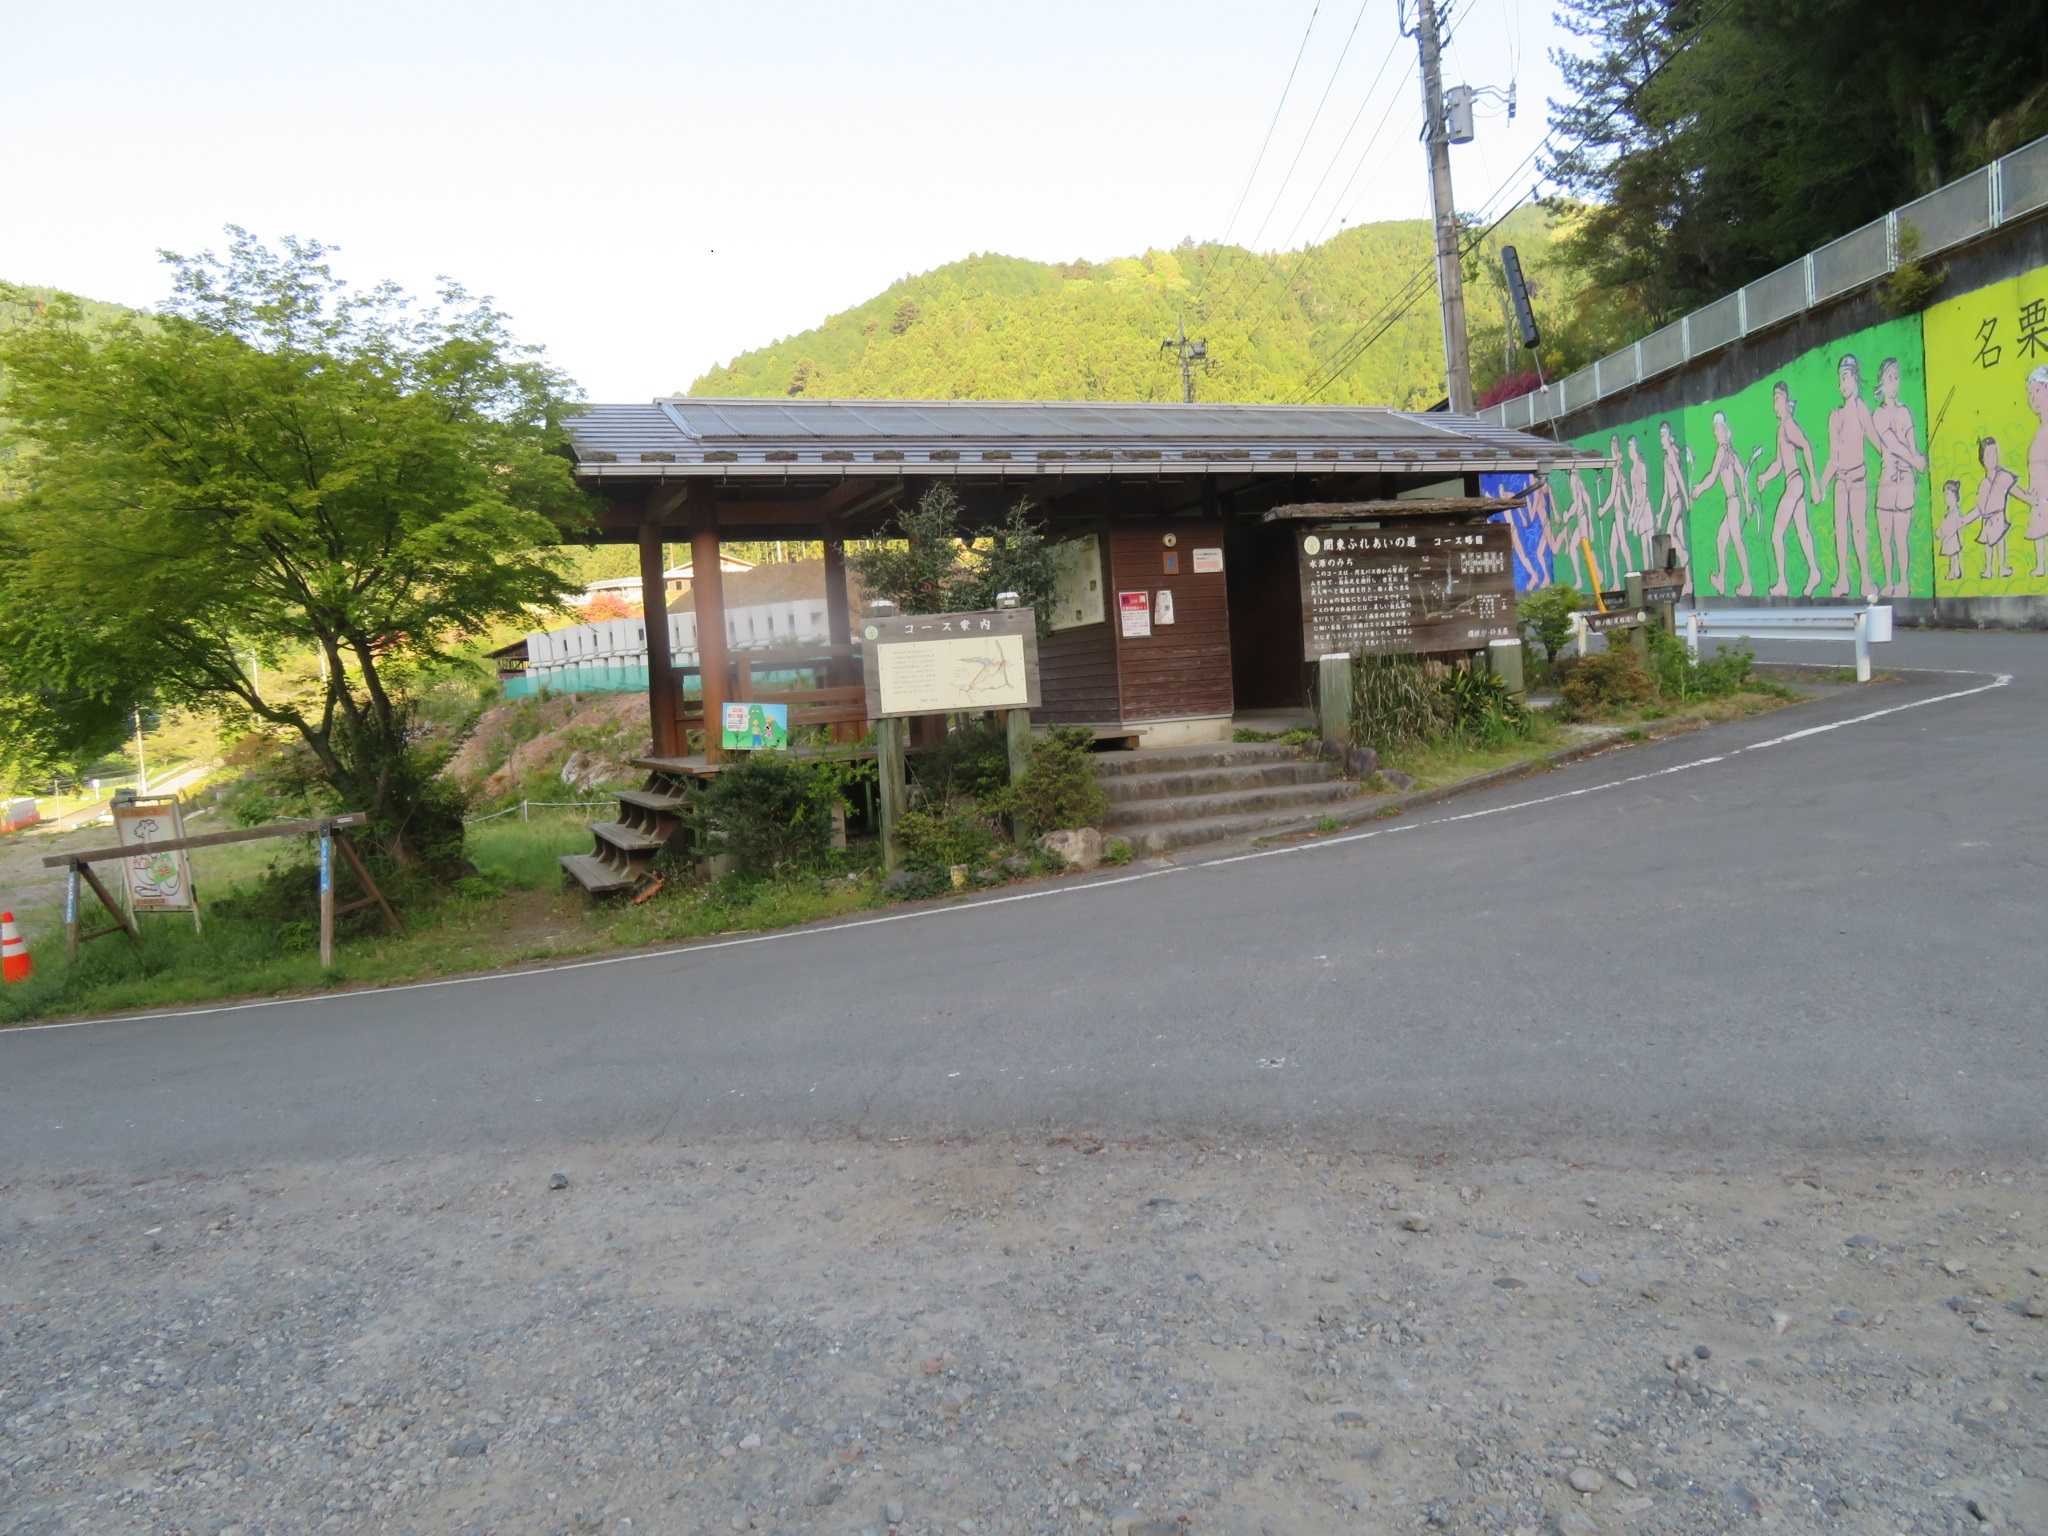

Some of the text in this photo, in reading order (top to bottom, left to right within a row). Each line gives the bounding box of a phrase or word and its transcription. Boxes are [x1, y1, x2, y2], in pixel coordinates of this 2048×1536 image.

[1972, 298, 2048, 369] 名栗
[1323, 535, 1417, 551] 関東ふれあいの道
[1434, 535, 1484, 546] コース略図
[904, 617, 992, 635] コース案内
